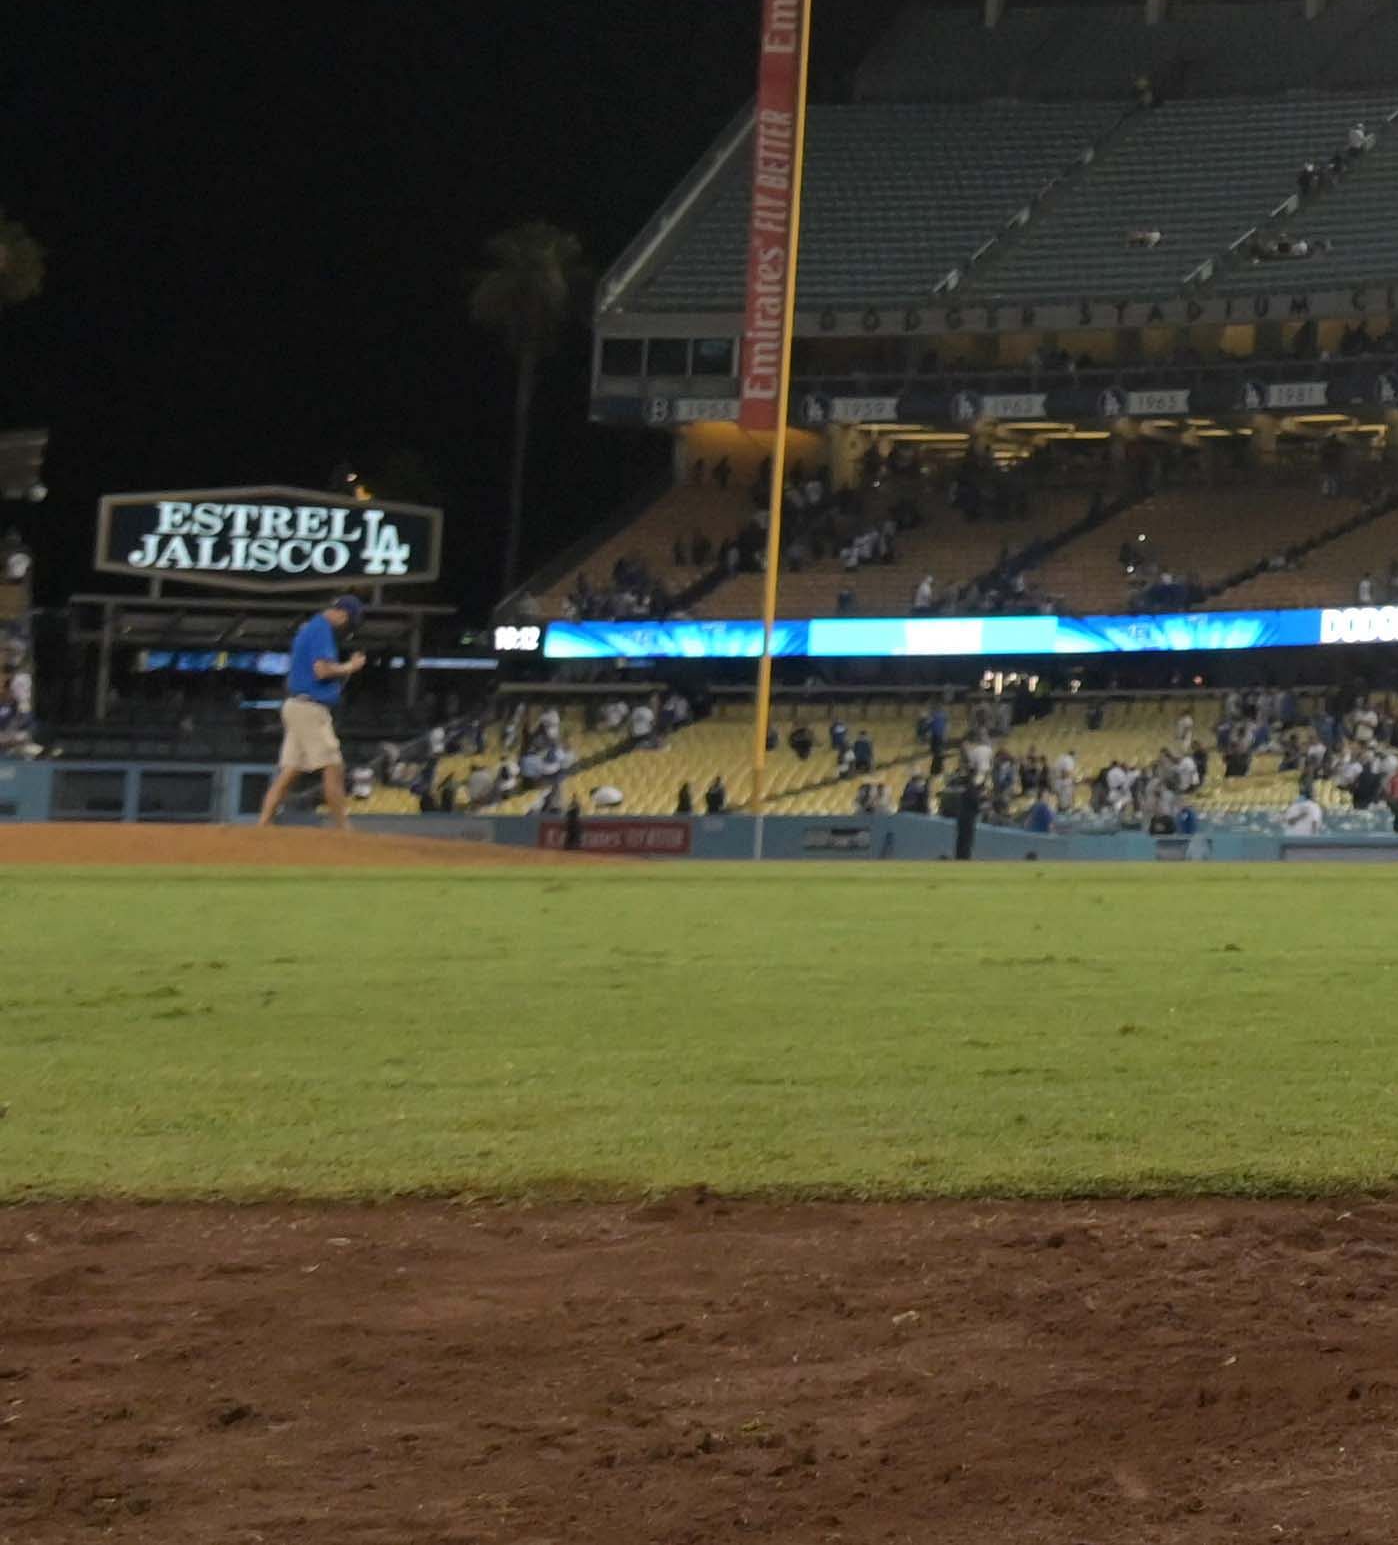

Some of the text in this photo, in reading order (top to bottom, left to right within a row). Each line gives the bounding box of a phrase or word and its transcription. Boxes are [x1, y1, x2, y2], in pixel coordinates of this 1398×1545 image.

[743, 110, 793, 400] Emirates FLY BETTER
[127, 534, 351, 574] JALISCO
[156, 501, 411, 575] ESTREL LA
